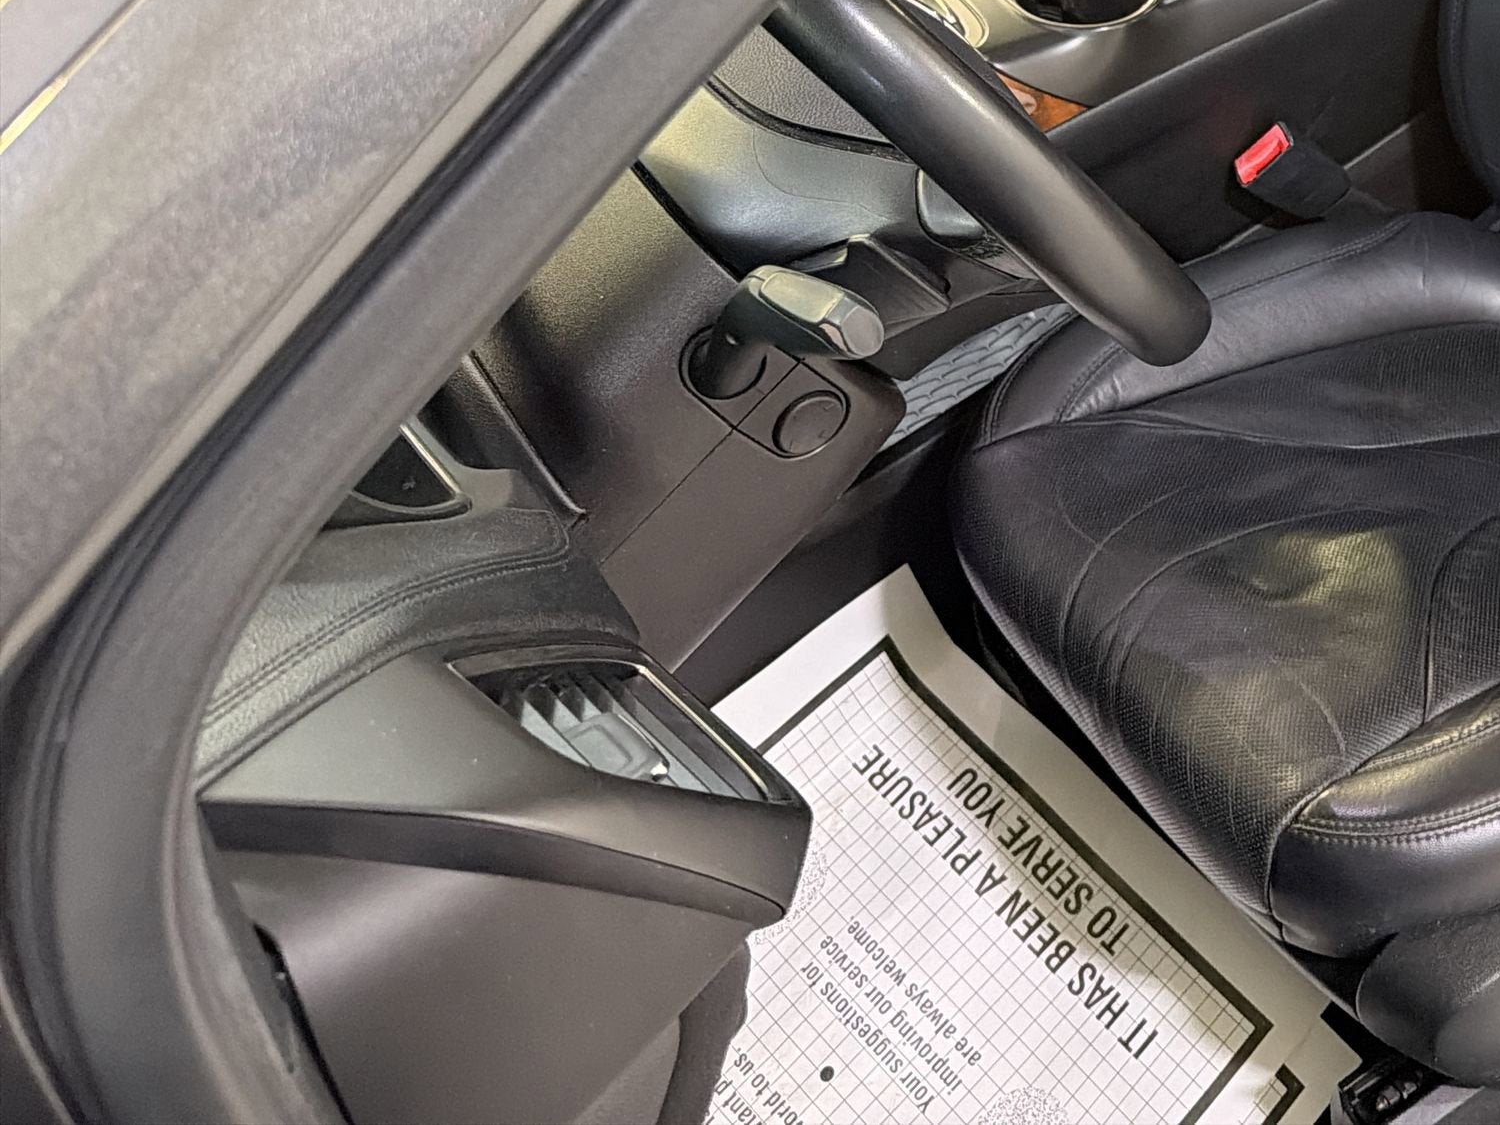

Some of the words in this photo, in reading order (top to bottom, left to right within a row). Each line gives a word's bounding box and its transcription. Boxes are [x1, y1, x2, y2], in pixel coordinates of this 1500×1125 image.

[852, 744, 983, 876] PLEASURE
[947, 768, 1006, 829] YOU
[974, 862, 1008, 898] A
[997, 815, 1094, 915] SERVE
[846, 915, 907, 987] welcome.
[995, 888, 1077, 974] BEEN
[1087, 906, 1130, 957] TO
[796, 961, 824, 989] for
[820, 935, 869, 989] service
[864, 986, 892, 1015] our
[904, 983, 957, 1039] always
[1067, 961, 1130, 1030] HAS
[817, 981, 904, 1074] suggestions
[889, 1009, 963, 1096] improving
[954, 1036, 982, 1066] are
[1117, 1018, 1158, 1060] IT
[751, 1073, 770, 1096] to
[899, 1071, 940, 1116] Your
